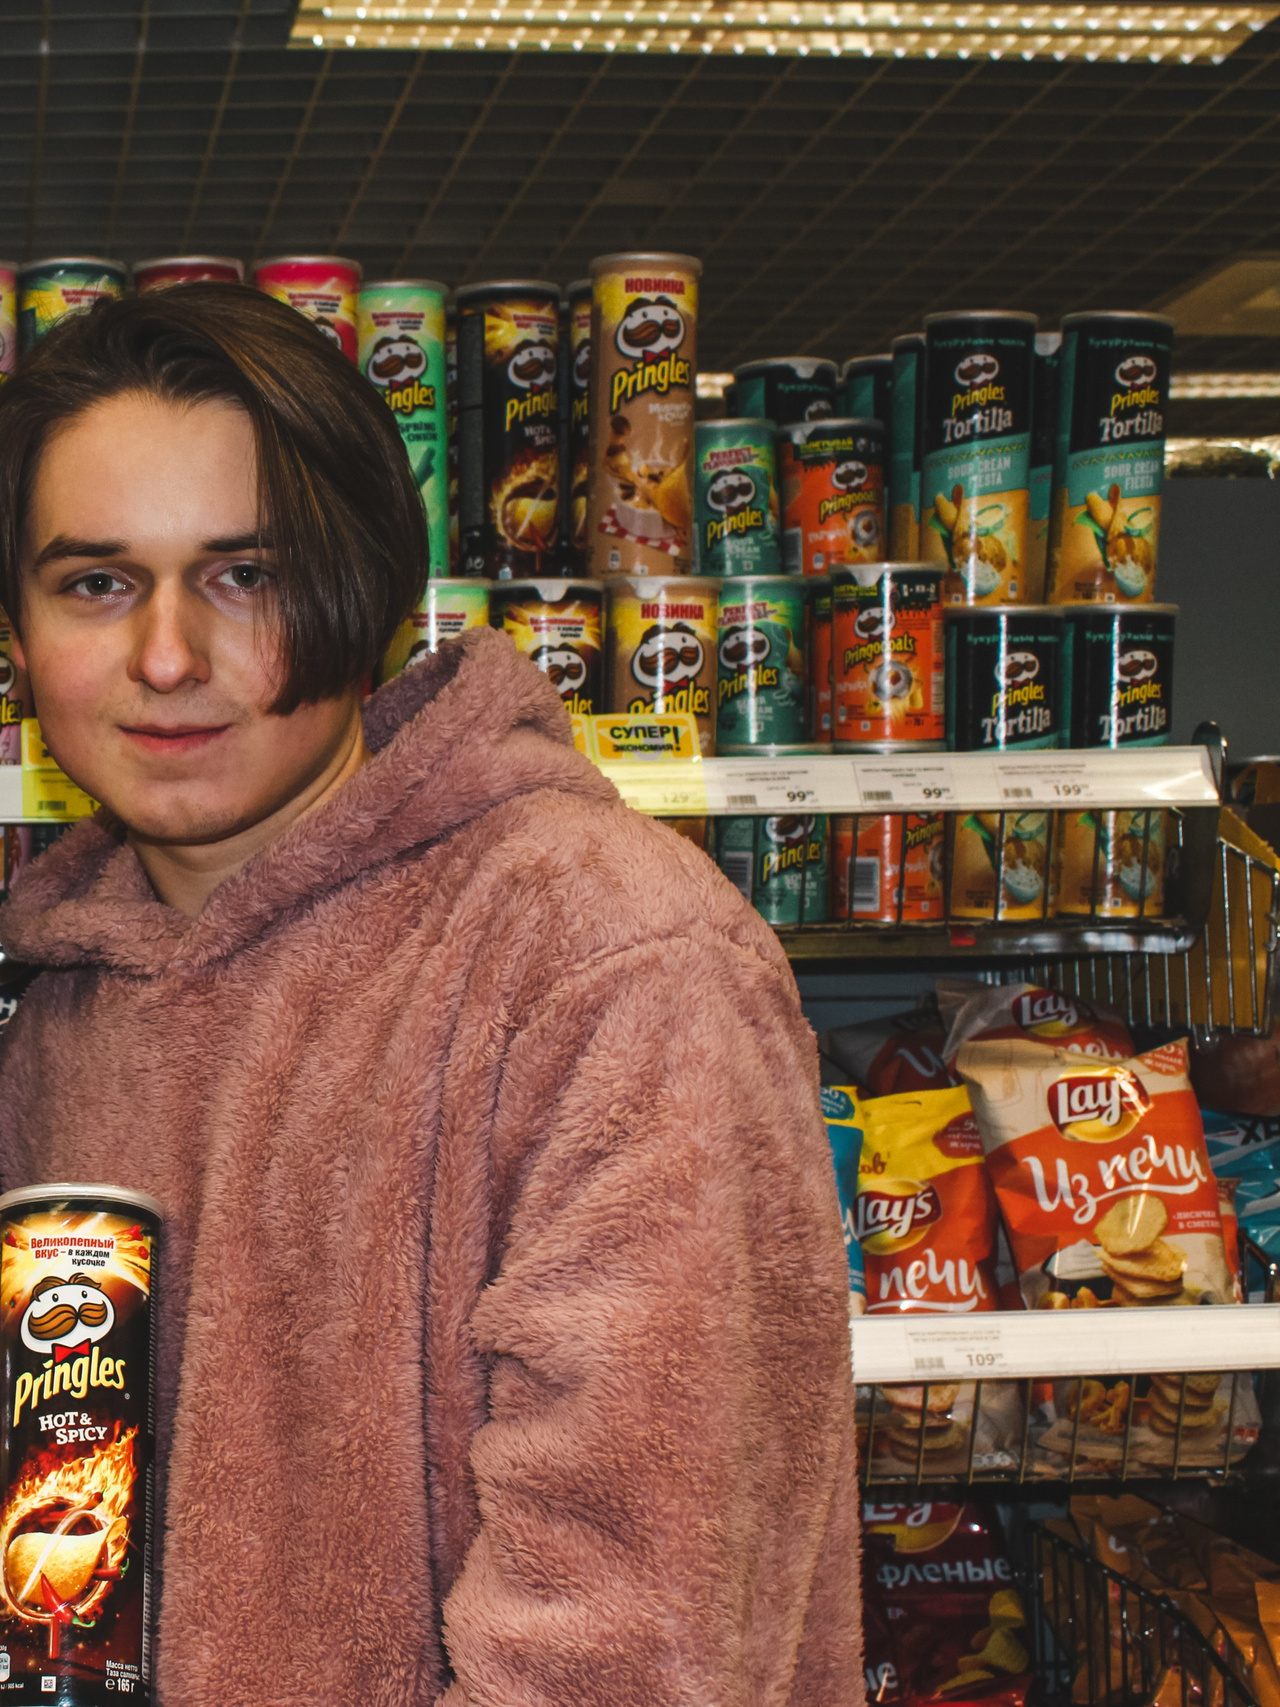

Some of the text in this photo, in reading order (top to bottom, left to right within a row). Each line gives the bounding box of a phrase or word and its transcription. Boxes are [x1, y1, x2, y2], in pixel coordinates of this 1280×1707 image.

[625, 278, 685, 294] НОВИНКА
[384, 378, 436, 413] ingles
[611, 354, 691, 412] Pringles
[505, 387, 558, 432] Pringl
[951, 382, 1005, 416] Pringles
[1110, 386, 1160, 416] Pringles
[943, 406, 1013, 443] Tortilla
[1099, 409, 1163, 443] Tortilla
[977, 456, 1012, 474] CREAM
[1103, 463, 1132, 479] SOUR
[707, 509, 763, 549] Pringles
[992, 681, 1045, 716] Pringles
[609, 725, 681, 751] СУПЕР!
[981, 706, 1051, 744] Tortilla
[1098, 705, 1167, 741] Tortilla
[786, 790, 806, 802] 99
[923, 787, 942, 799] 99
[1053, 784, 1081, 796] 199
[762, 842, 821, 883] Pringles
[1022, 1133, 1207, 1224] Из печи
[856, 1190, 934, 1239] Lay's
[31, 1236, 115, 1250] Великолепный
[35, 1248, 59, 1260] вкус
[75, 1250, 110, 1258] каждом
[72, 1258, 106, 1267] кусочке
[880, 1247, 987, 1301] печи
[966, 1353, 995, 1367] 109
[13, 1346, 126, 1428] Pringles
[38, 1412, 92, 1432] HOT &
[56, 1427, 108, 1446] SPICY
[876, 1556, 1012, 1589] фленые
[106, 1659, 124, 1670] Масса
[117, 1678, 130, 1692] 165
